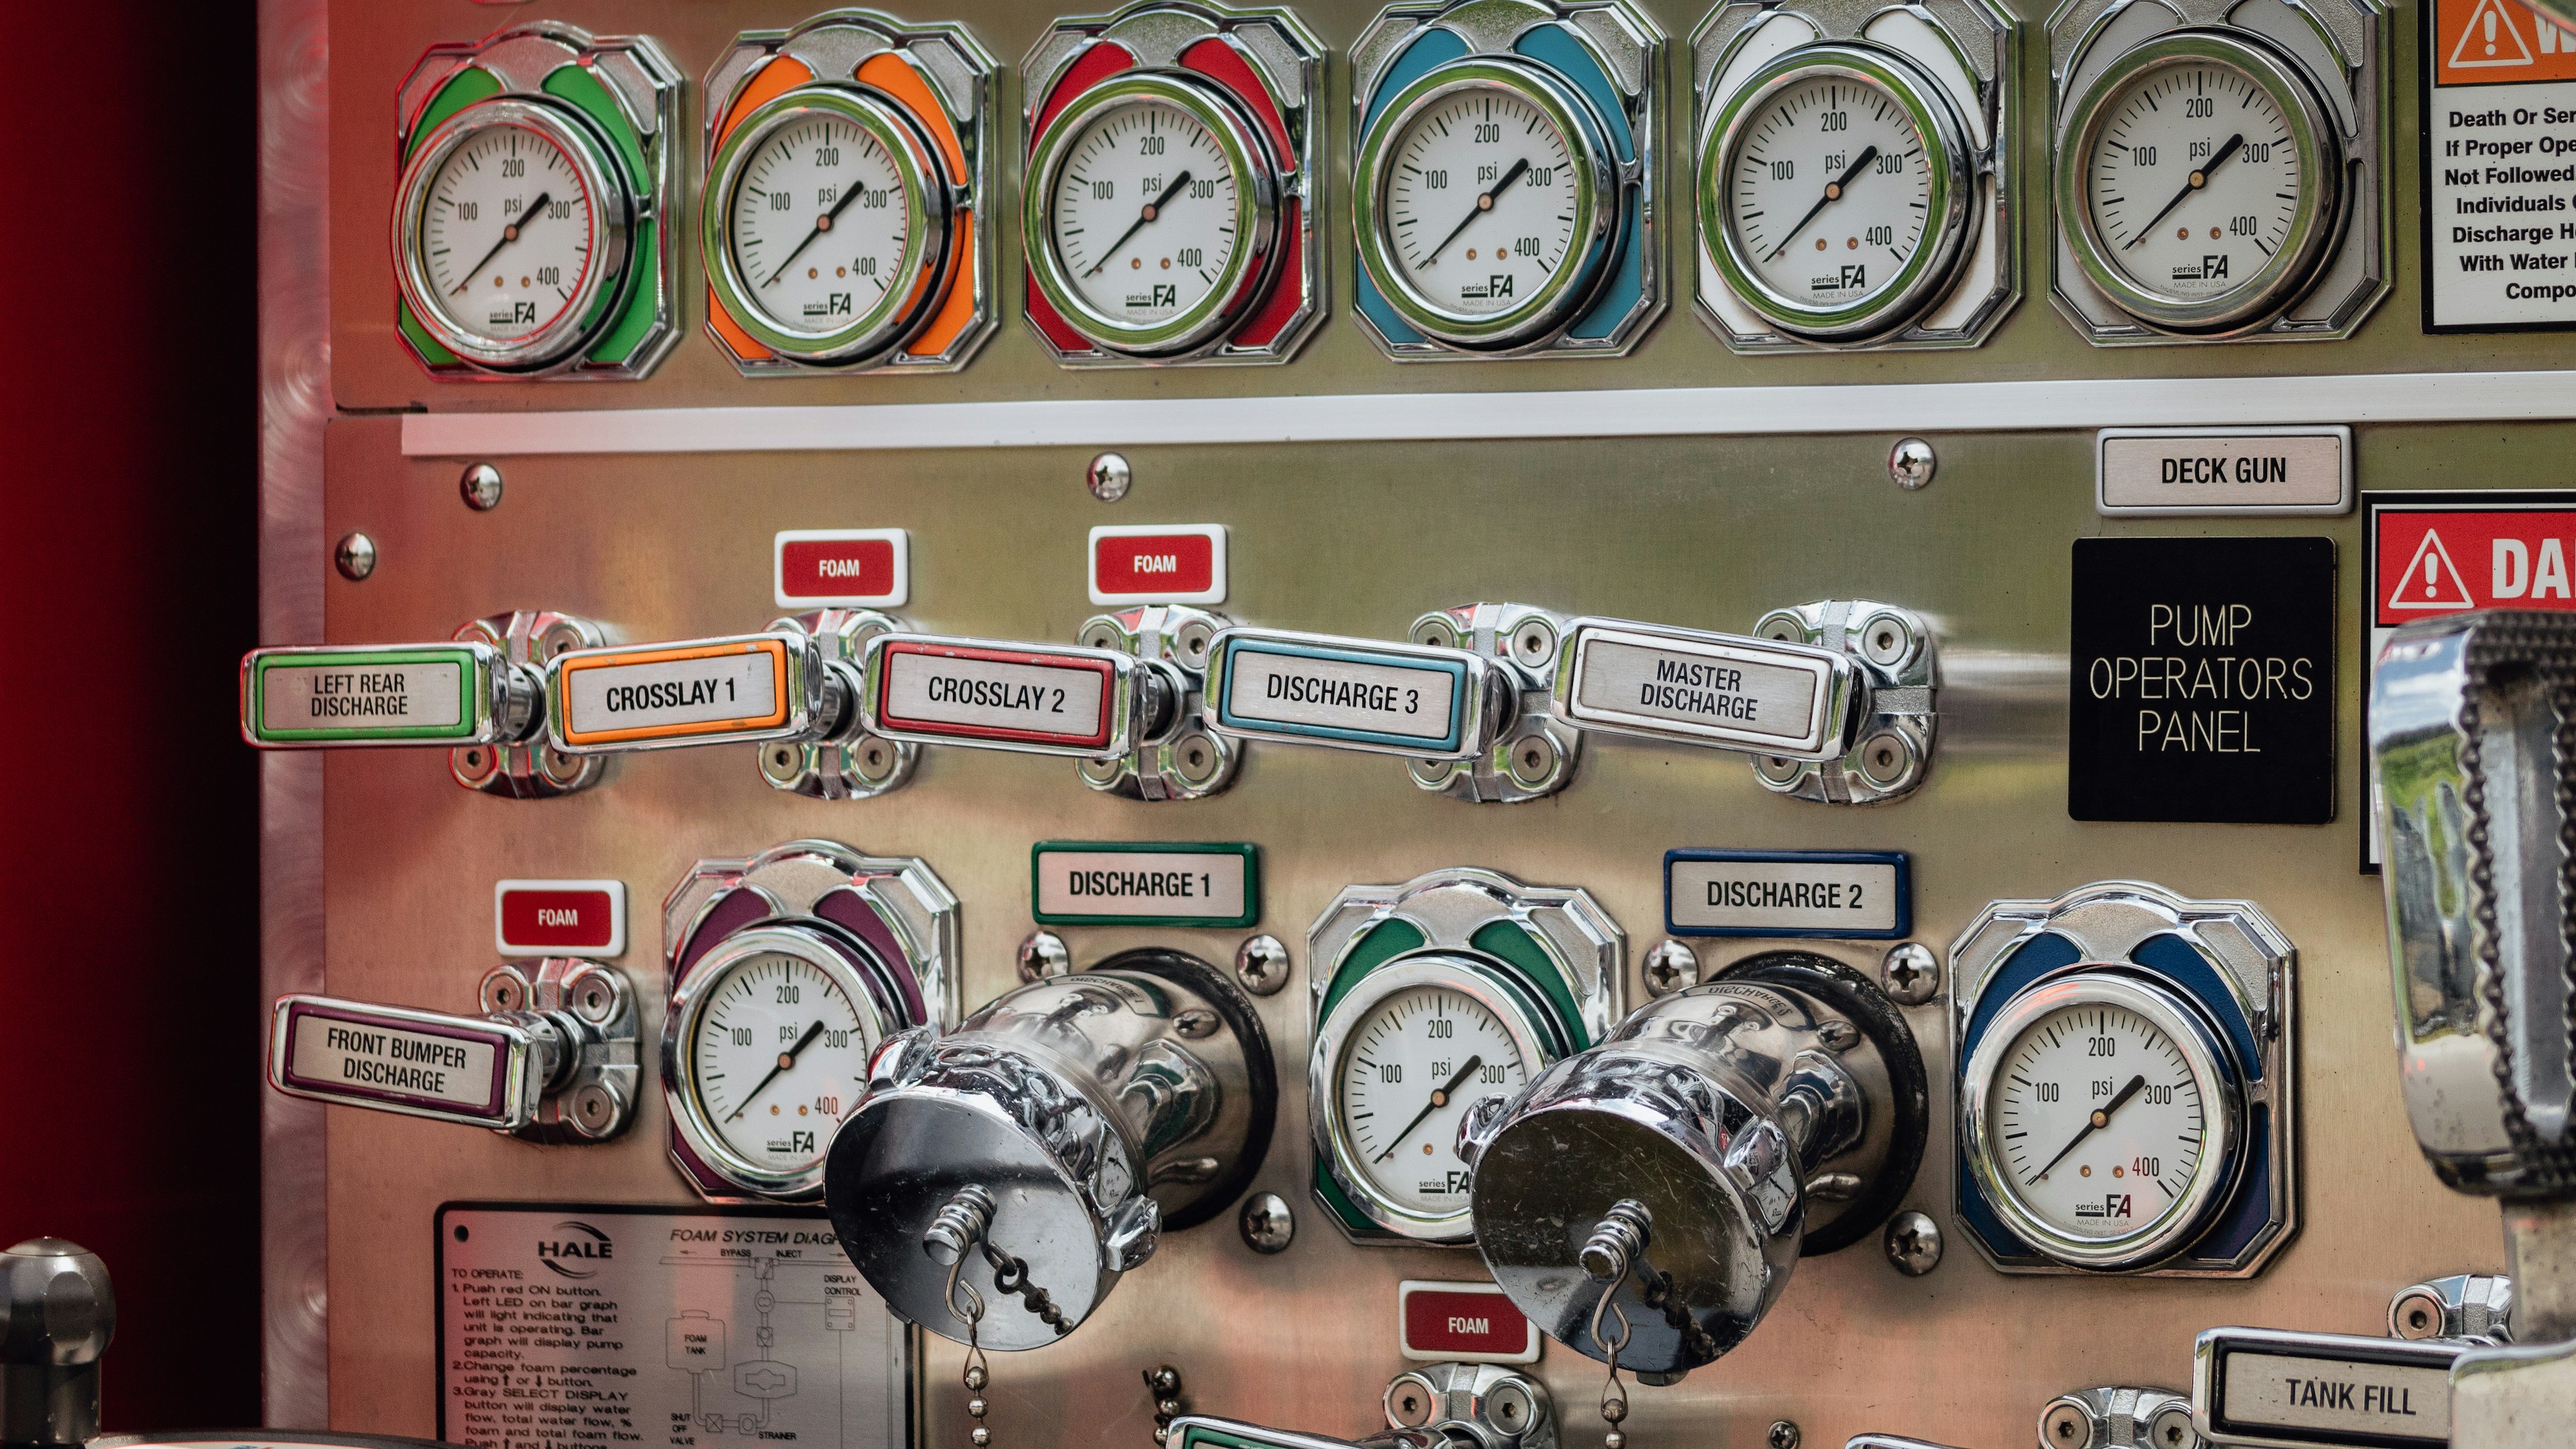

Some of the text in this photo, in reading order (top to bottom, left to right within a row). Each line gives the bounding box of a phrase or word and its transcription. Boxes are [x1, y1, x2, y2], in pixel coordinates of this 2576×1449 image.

[2186, 98, 2212, 117] 200
[2449, 107, 2576, 127] Death Or Ser
[1821, 112, 1846, 132] 200
[1475, 124, 1499, 142] 200
[1141, 137, 1164, 155] 200
[2190, 138, 2212, 162] psi
[2243, 143, 2269, 164] 300
[2446, 137, 2576, 159] If Proper Ope
[816, 147, 839, 166] 200
[1825, 148, 1845, 173] psi
[1875, 154, 1903, 175] 300
[2132, 147, 2156, 166] 100
[502, 159, 524, 177] 200
[1478, 162, 1498, 184] psi
[1526, 167, 1551, 187] 300
[1770, 160, 1793, 180] 100
[2445, 165, 2576, 185] Not Followed
[1143, 172, 1162, 195] psi
[1189, 180, 1214, 199] 300
[1425, 170, 1447, 189] 100
[818, 182, 838, 205] psi
[863, 190, 887, 210] 300
[1092, 181, 1113, 200] 100
[504, 194, 523, 216] psi
[547, 201, 570, 220] 300
[770, 192, 790, 210] 100
[2457, 195, 2565, 213] Individuals
[458, 203, 477, 220] 100
[1865, 226, 1891, 245] 400
[2230, 216, 2256, 235] 400
[2453, 223, 2576, 245] Discharge H
[1515, 238, 1539, 256] 400
[853, 258, 875, 275] 400
[1178, 248, 1201, 267] 400
[2172, 255, 2228, 279] series FA
[2459, 254, 2567, 271] With Water
[537, 267, 559, 285] 400
[1812, 265, 1865, 289] series FA
[1126, 285, 1176, 307] series FA
[1461, 275, 1513, 298] series FA
[2506, 283, 2576, 302] Compo
[514, 302, 535, 323] FA
[829, 293, 851, 315] FA
[2162, 457, 2285, 484] DECK GUN
[819, 560, 859, 577] FOAM
[1134, 555, 1176, 572] FOAM
[2492, 538, 2576, 598] DA
[2152, 605, 2251, 646] PUMP
[315, 673, 404, 694] LEFT REAR
[1657, 660, 1742, 693] MASTER
[2090, 658, 2312, 700] OPERATORS
[607, 678, 736, 712] CROSSLAY 1
[929, 677, 1065, 713] CROSSLAY 2
[1267, 674, 1418, 713] DISCHARGE 3
[1640, 683, 1758, 721] DISCHARGE
[311, 696, 407, 717] DISCHARGE
[2140, 711, 2260, 751] PANEL
[1070, 872, 1211, 897] DISCHARGE 1
[1708, 882, 1862, 908] DISCHARGE 2
[539, 909, 577, 926] FOAM
[776, 985, 799, 1004] 200
[731, 1028, 751, 1046] 100
[780, 1022, 799, 1044] psi
[824, 1030, 848, 1048] 300
[1428, 1020, 1452, 1038] 200
[328, 1028, 466, 1070] FRONT BUMPER
[2089, 1038, 2114, 1057] 200
[343, 1058, 445, 1094] DISCHARGE
[1380, 1065, 1401, 1083] 100
[1431, 1059, 1451, 1081] psi
[1480, 1065, 1505, 1085] 300
[2035, 1083, 2059, 1102] 100
[2091, 1075, 2113, 1100] psi
[2144, 1085, 2172, 1106] 300
[815, 1097, 837, 1114] 400
[793, 1131, 814, 1153] FA
[2132, 1157, 2159, 1176] 400
[1419, 1171, 1470, 1194] series FA
[2076, 1194, 2130, 1218] series FA
[670, 1229, 717, 1241] FOAM
[722, 1230, 789, 1244] SYSTEM
[538, 1241, 612, 1258] HALE
[451, 1269, 467, 1278] TO
[463, 1283, 495, 1293] Push
[501, 1284, 523, 1294] red
[529, 1285, 550, 1294] ON
[556, 1285, 602, 1297] button.
[824, 1287, 861, 1296] CONTROL
[463, 1297, 490, 1307] Left
[495, 1297, 523, 1307] LED
[551, 1299, 573, 1308] bar
[580, 1300, 618, 1310] graph
[464, 1309, 618, 1323] will light indicating that
[1449, 1317, 1488, 1334] FOAM
[464, 1323, 487, 1332] unit
[494, 1324, 504, 1332] is
[581, 1326, 604, 1335] Bar
[464, 1337, 501, 1346] graph
[535, 1338, 580, 1349] display
[587, 1341, 623, 1350] pump
[2285, 1377, 2416, 1415] TANK FILL
[758, 1432, 796, 1440] STRAINER
